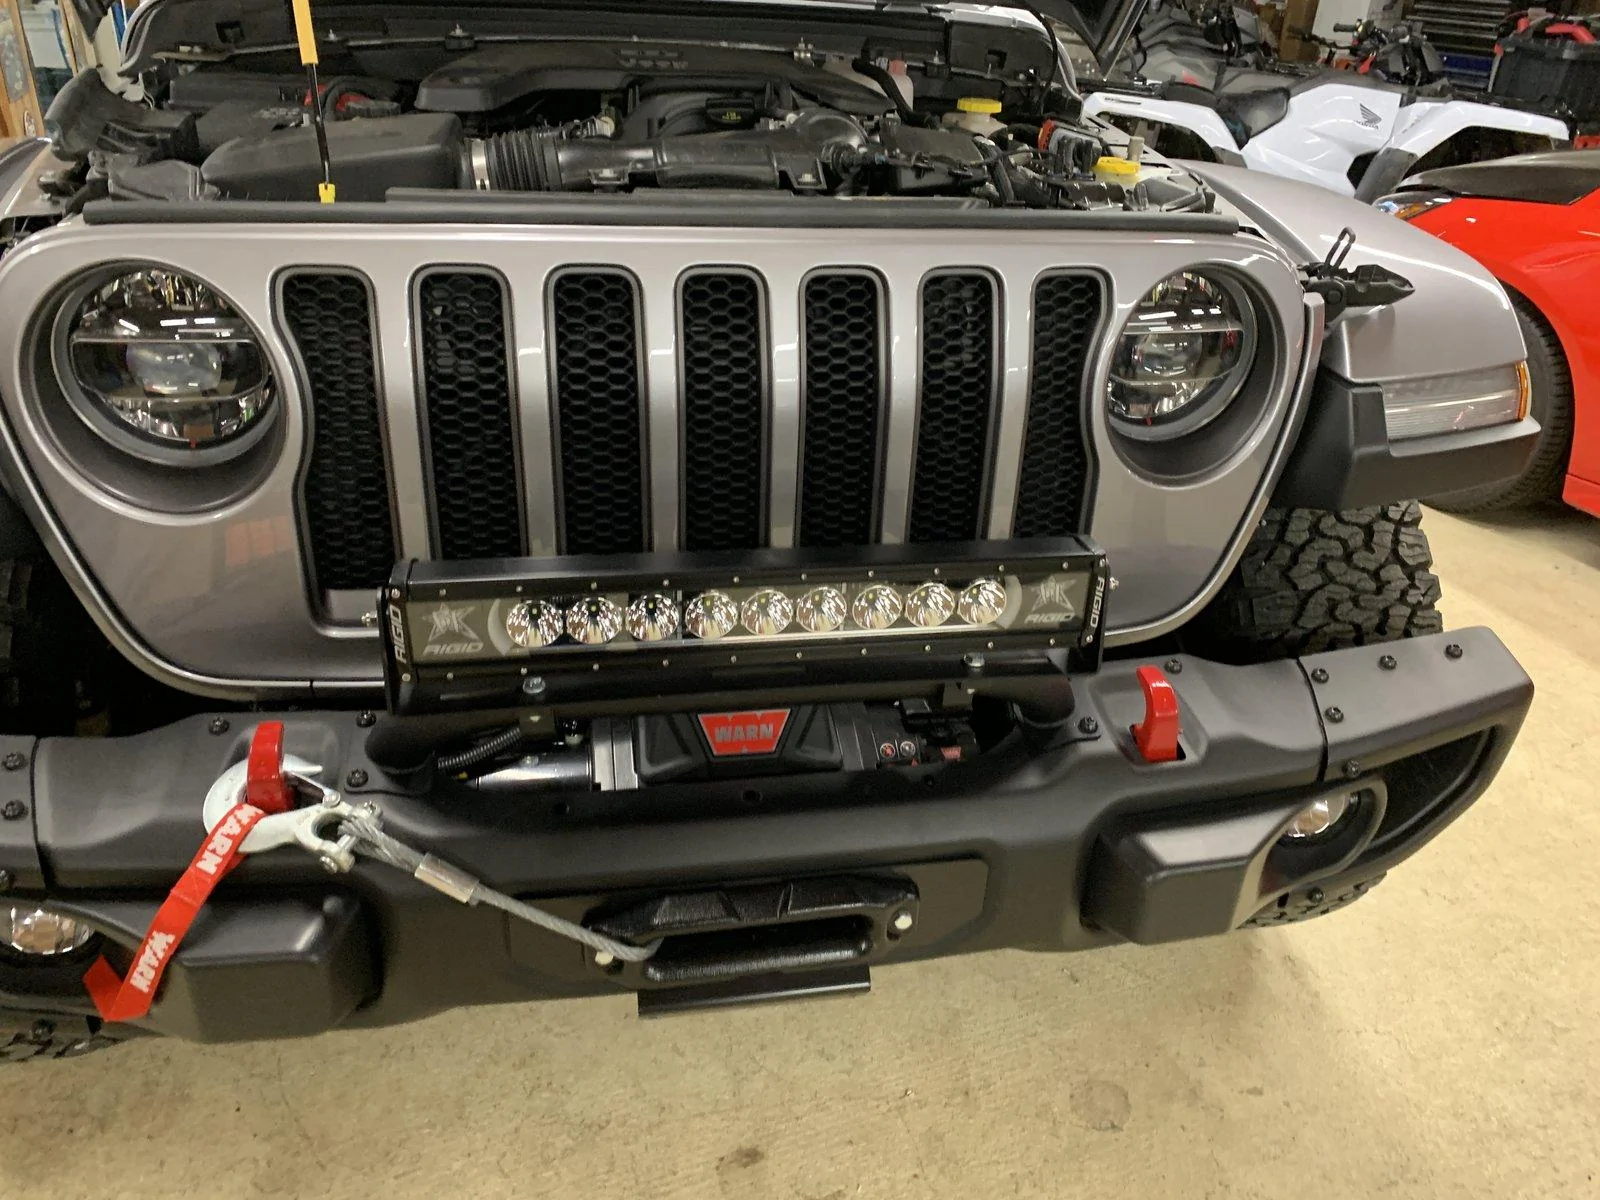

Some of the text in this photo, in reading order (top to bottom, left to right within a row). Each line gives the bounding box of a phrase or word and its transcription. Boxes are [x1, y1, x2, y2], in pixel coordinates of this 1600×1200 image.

[1090, 575, 1105, 628] RIGID
[389, 604, 407, 664] RIGID
[422, 641, 484, 656] RIGID
[715, 723, 774, 743] WARN
[195, 803, 265, 876] WARN
[130, 930, 176, 994] WARN
